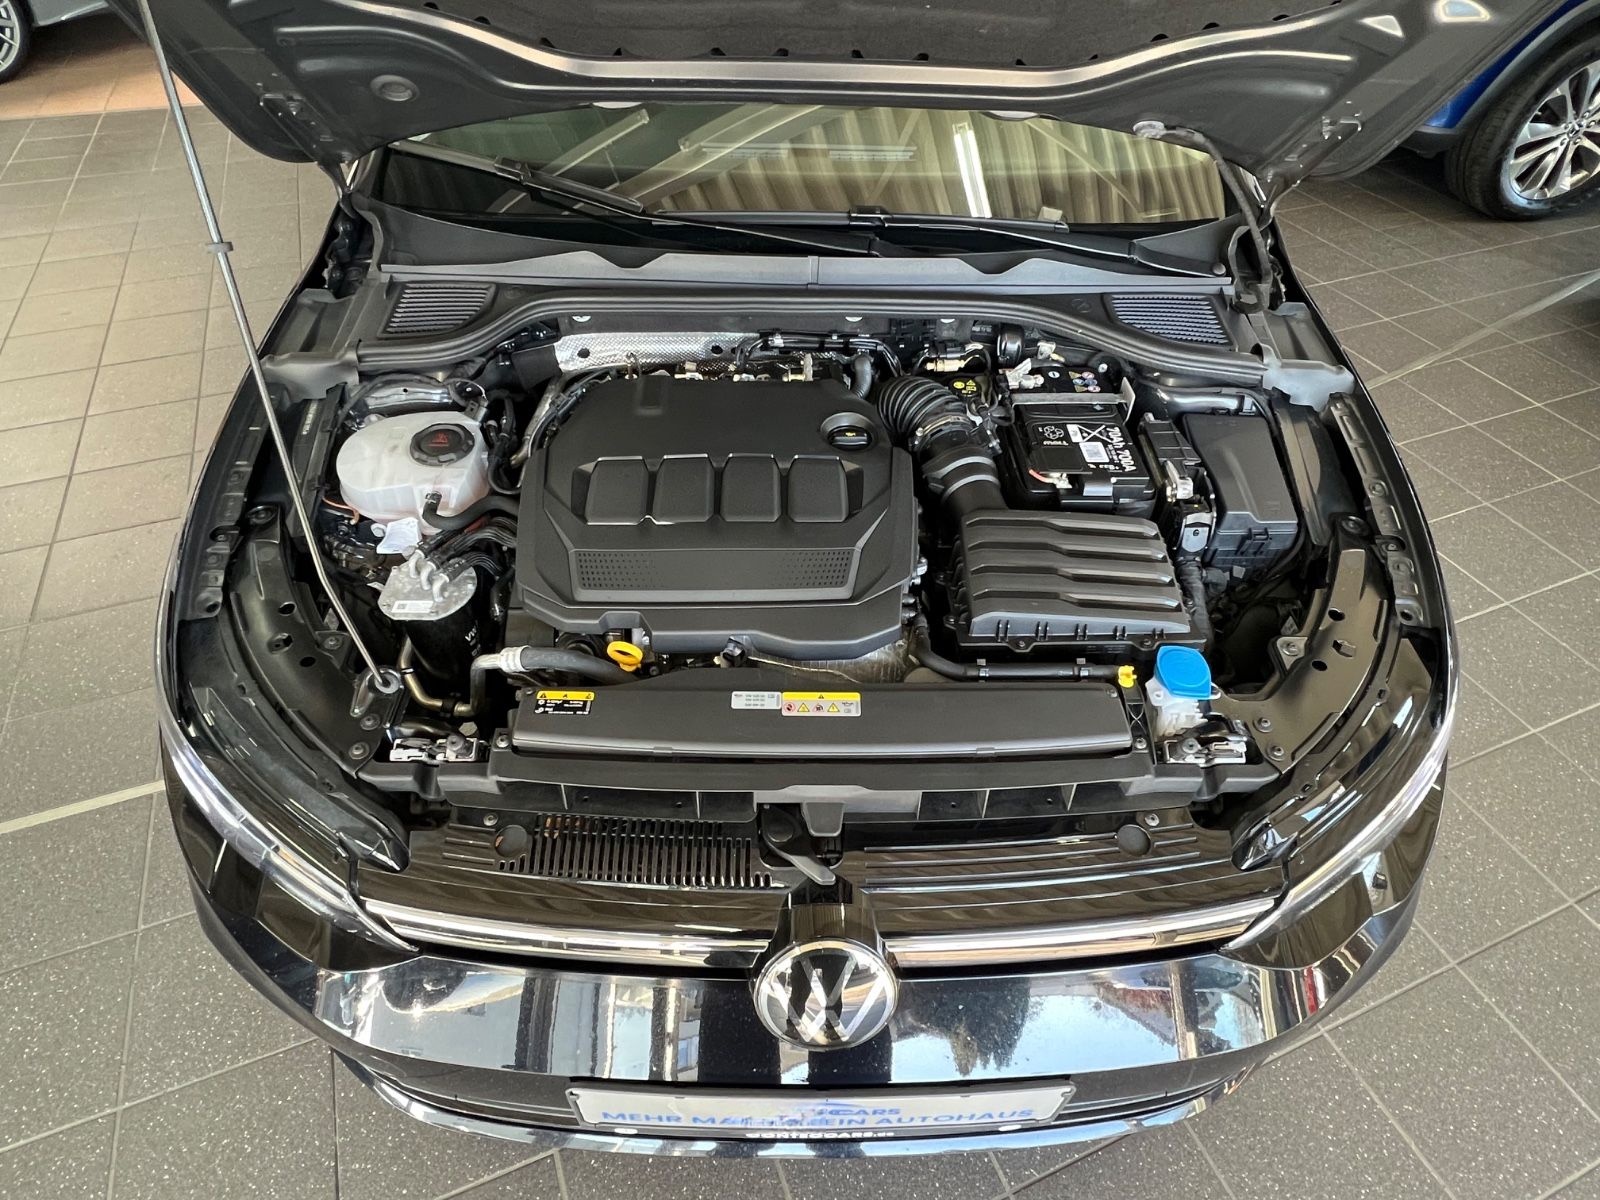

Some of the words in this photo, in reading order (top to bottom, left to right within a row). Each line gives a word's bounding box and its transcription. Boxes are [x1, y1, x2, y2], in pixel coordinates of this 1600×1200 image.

[1116, 449, 1137, 472] 700A
[601, 1111, 683, 1123] MEHR
[875, 1108, 1035, 1125] AUTOHAUS
